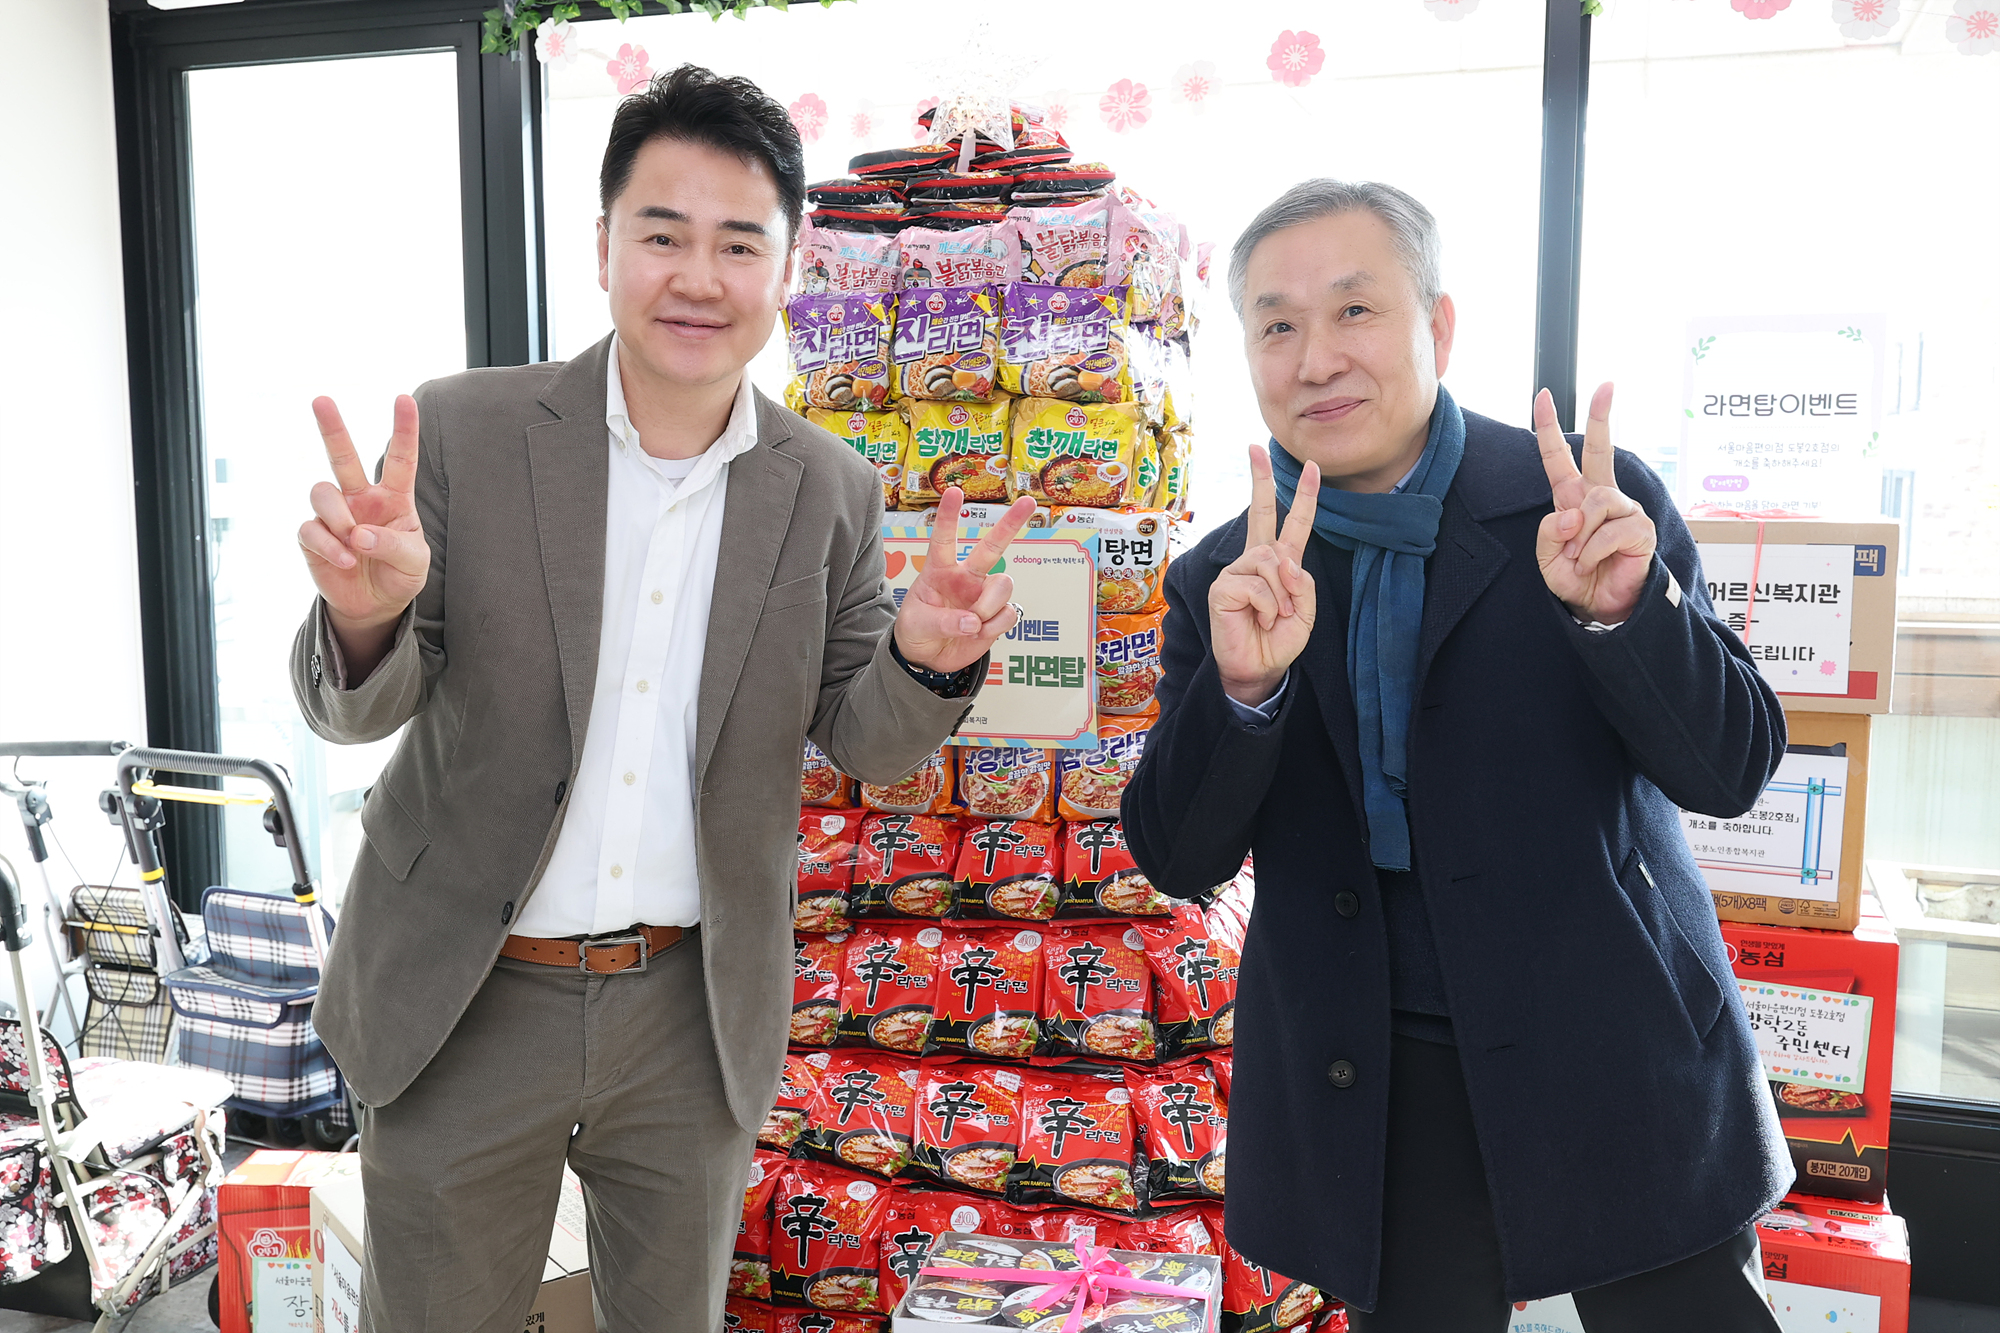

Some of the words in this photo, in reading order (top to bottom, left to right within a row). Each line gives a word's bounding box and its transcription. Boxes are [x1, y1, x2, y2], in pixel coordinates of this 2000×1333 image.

[934, 258, 1006, 288] 불닭볶음면
[797, 325, 878, 372] 진라면
[897, 315, 983, 362] 진라면
[1003, 315, 1109, 363] 진라면
[1703, 393, 1858, 417] 라면탑이벤트
[842, 434, 898, 463] 깨라면
[916, 427, 1004, 459] 참깨라면
[1025, 427, 1119, 460] 참깨라면
[1717, 441, 1784, 455] 서울마음편의점
[1788, 441, 1840, 455] 도봉2호점의
[1733, 456, 1760, 471] 개소를
[1013, 555, 1042, 566] dobong
[1098, 538, 1153, 566] 탕면
[1008, 655, 1086, 688] 라면탑
[1688, 819, 1717, 832] 개소를
[1722, 822, 1774, 836] 축하합니다.
[910, 843, 942, 857] 라면
[1014, 844, 1047, 858] 라면
[1692, 844, 1765, 858] 도봉노인종합복지관
[802, 862, 831, 874] 라면
[1740, 948, 1784, 968] 농심
[1763, 941, 1785, 950] 맛있게
[856, 941, 908, 1009] 辛
[895, 974, 928, 989] 라면
[950, 946, 1005, 1015] 辛
[994, 979, 1028, 994] 라면
[1059, 941, 1117, 1012] 辛
[1105, 977, 1140, 993] 라면
[1776, 1034, 1850, 1060] 주민센터
[830, 1069, 886, 1125] 辛
[928, 1080, 986, 1142] 辛
[1160, 1082, 1213, 1153] 辛
[1038, 1095, 1097, 1160] 辛
[1084, 1130, 1121, 1144] 라면
[1810, 1161, 1837, 1175] 봉지면
[1838, 1164, 1868, 1180] 20개입
[781, 1192, 838, 1269] 辛
[827, 1233, 861, 1249] 라면
[256, 1246, 279, 1257] 오뚜기
[1765, 1251, 1789, 1261] 맛있게
[1765, 1261, 1787, 1279] 심
[283, 1294, 312, 1318] 장
[525, 1311, 545, 1327] 있게
